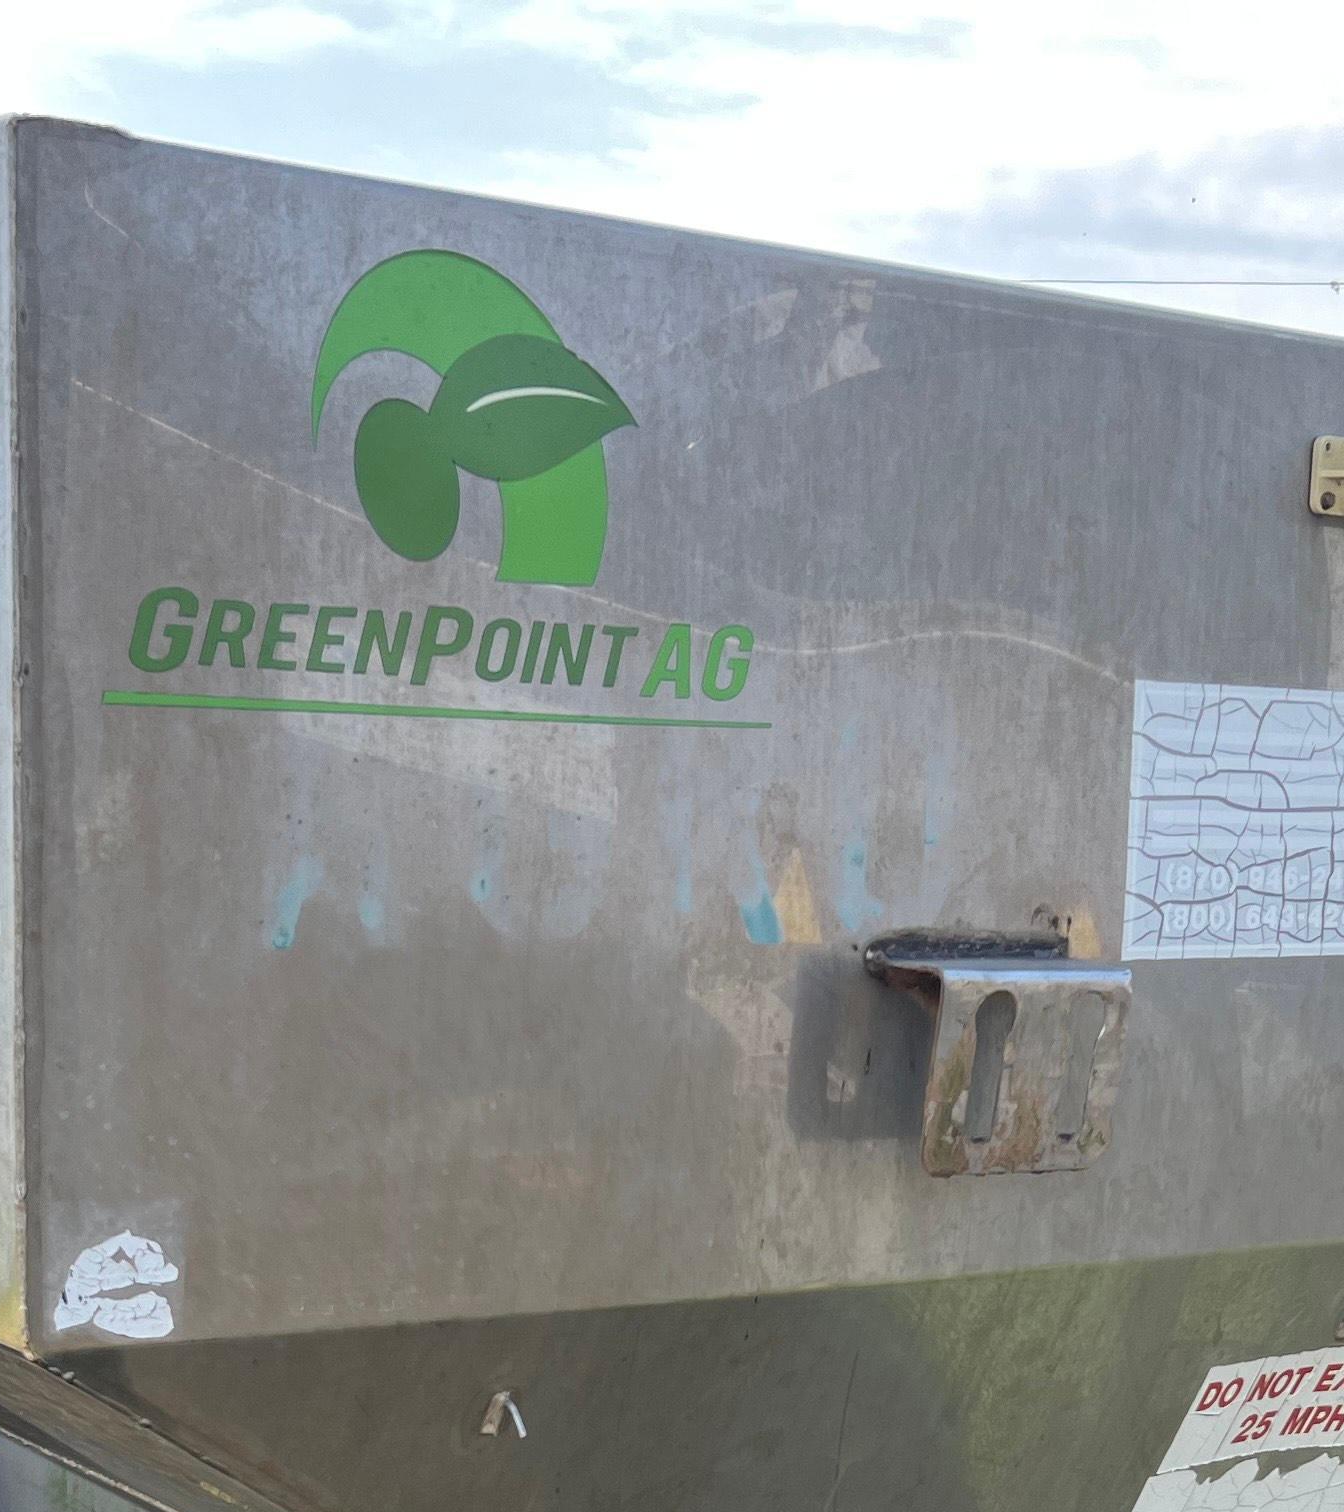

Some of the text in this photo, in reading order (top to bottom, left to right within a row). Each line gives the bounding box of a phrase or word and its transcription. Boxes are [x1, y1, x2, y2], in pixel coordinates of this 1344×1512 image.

[128, 585, 755, 702] GREENPOINT AG
[1195, 1377, 1244, 1412] DO
[1248, 1366, 1314, 1402] NOT
[1230, 1411, 1278, 1445] 25
